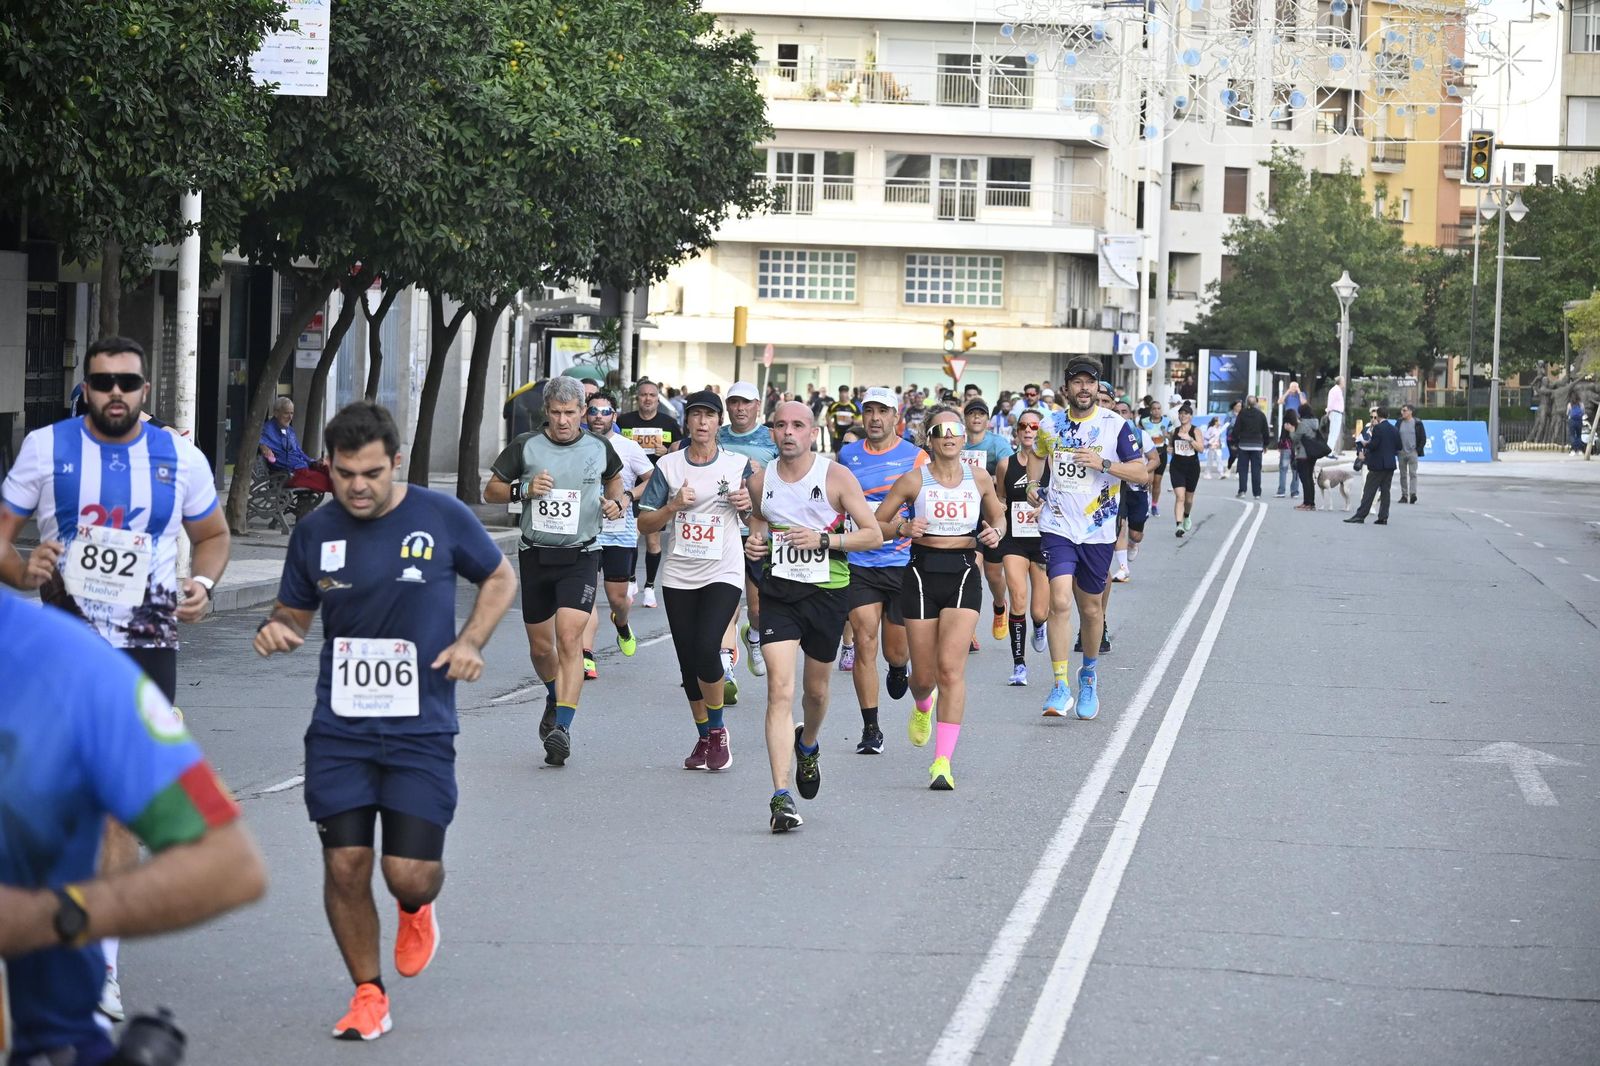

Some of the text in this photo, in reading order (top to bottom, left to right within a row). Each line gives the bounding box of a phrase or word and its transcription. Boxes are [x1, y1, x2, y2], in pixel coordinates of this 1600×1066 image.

[637, 434, 658, 445] 503
[1058, 462, 1087, 478] 593
[539, 500, 572, 518] 833
[934, 501, 967, 519] 861
[544, 522, 565, 530] Huelva
[682, 523, 716, 543] 834
[939, 524, 961, 532] Huelva
[685, 546, 707, 555] Huelva
[775, 545, 826, 564] 1009
[80, 544, 138, 578] 892
[83, 582, 121, 598] Huelva
[1013, 622, 1023, 656] Kalenji
[338, 659, 413, 687] 1006
[352, 699, 391, 710] Huelva
